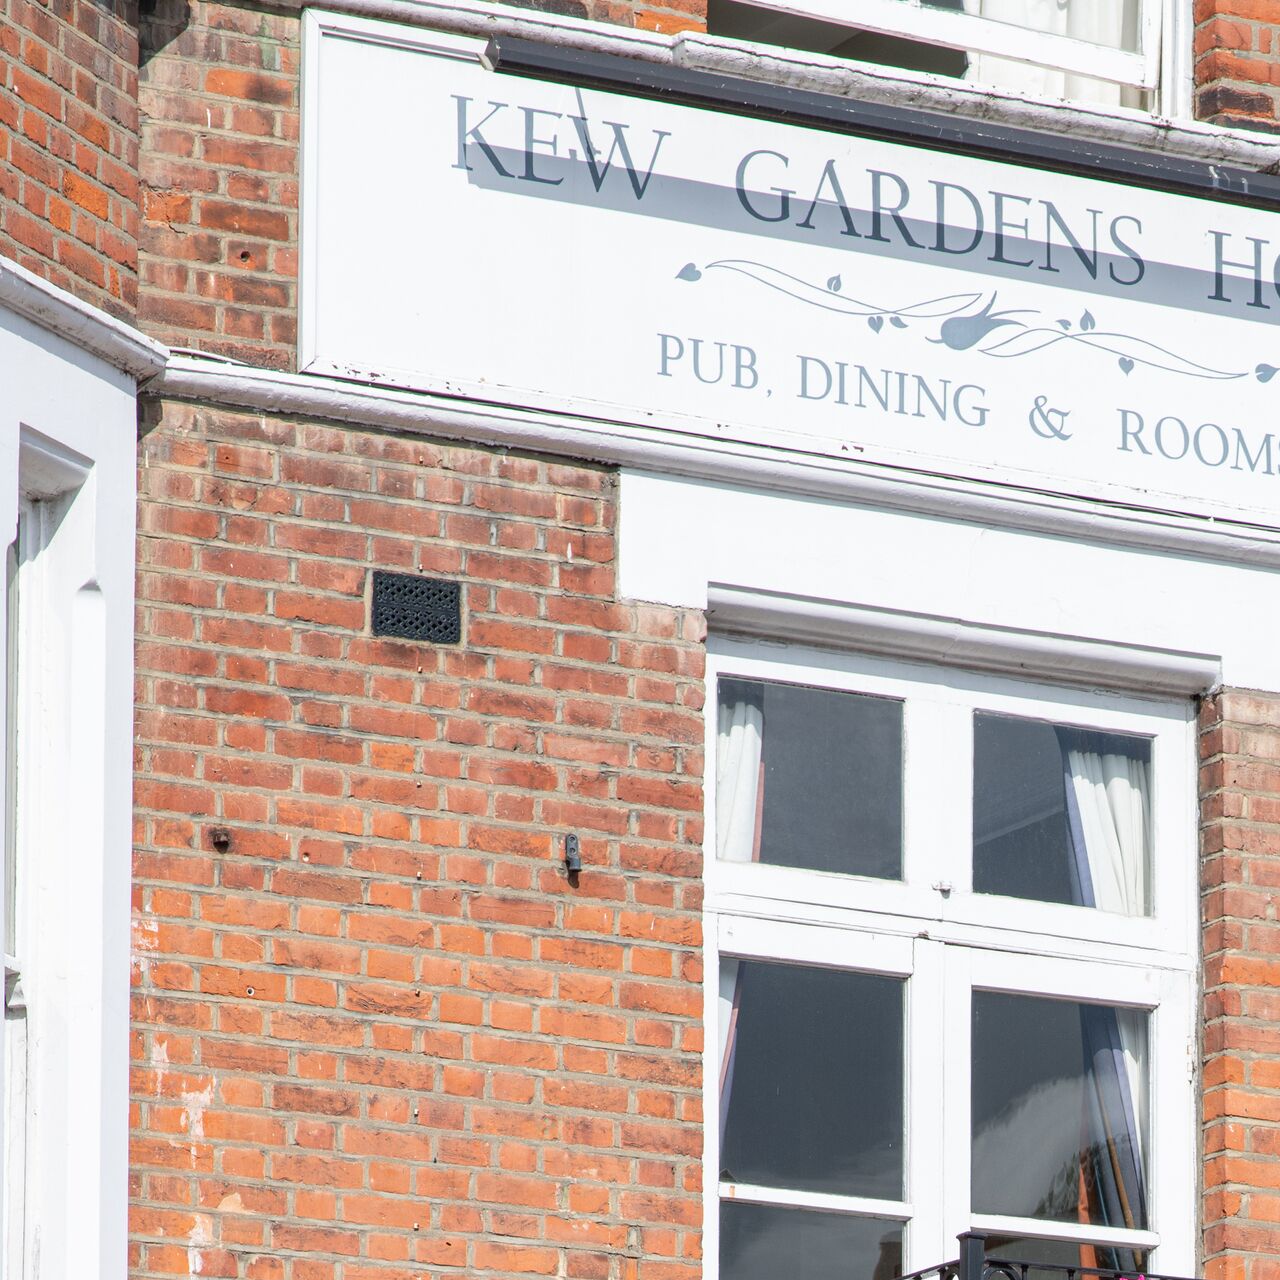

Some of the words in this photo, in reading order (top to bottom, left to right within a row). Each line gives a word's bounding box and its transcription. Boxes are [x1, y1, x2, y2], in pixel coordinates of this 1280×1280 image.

[451, 94, 671, 200] KEW
[735, 149, 1146, 287] GARDENS
[656, 333, 774, 399] PUB,
[796, 354, 991, 428] DINING
[1028, 395, 1073, 441] &
